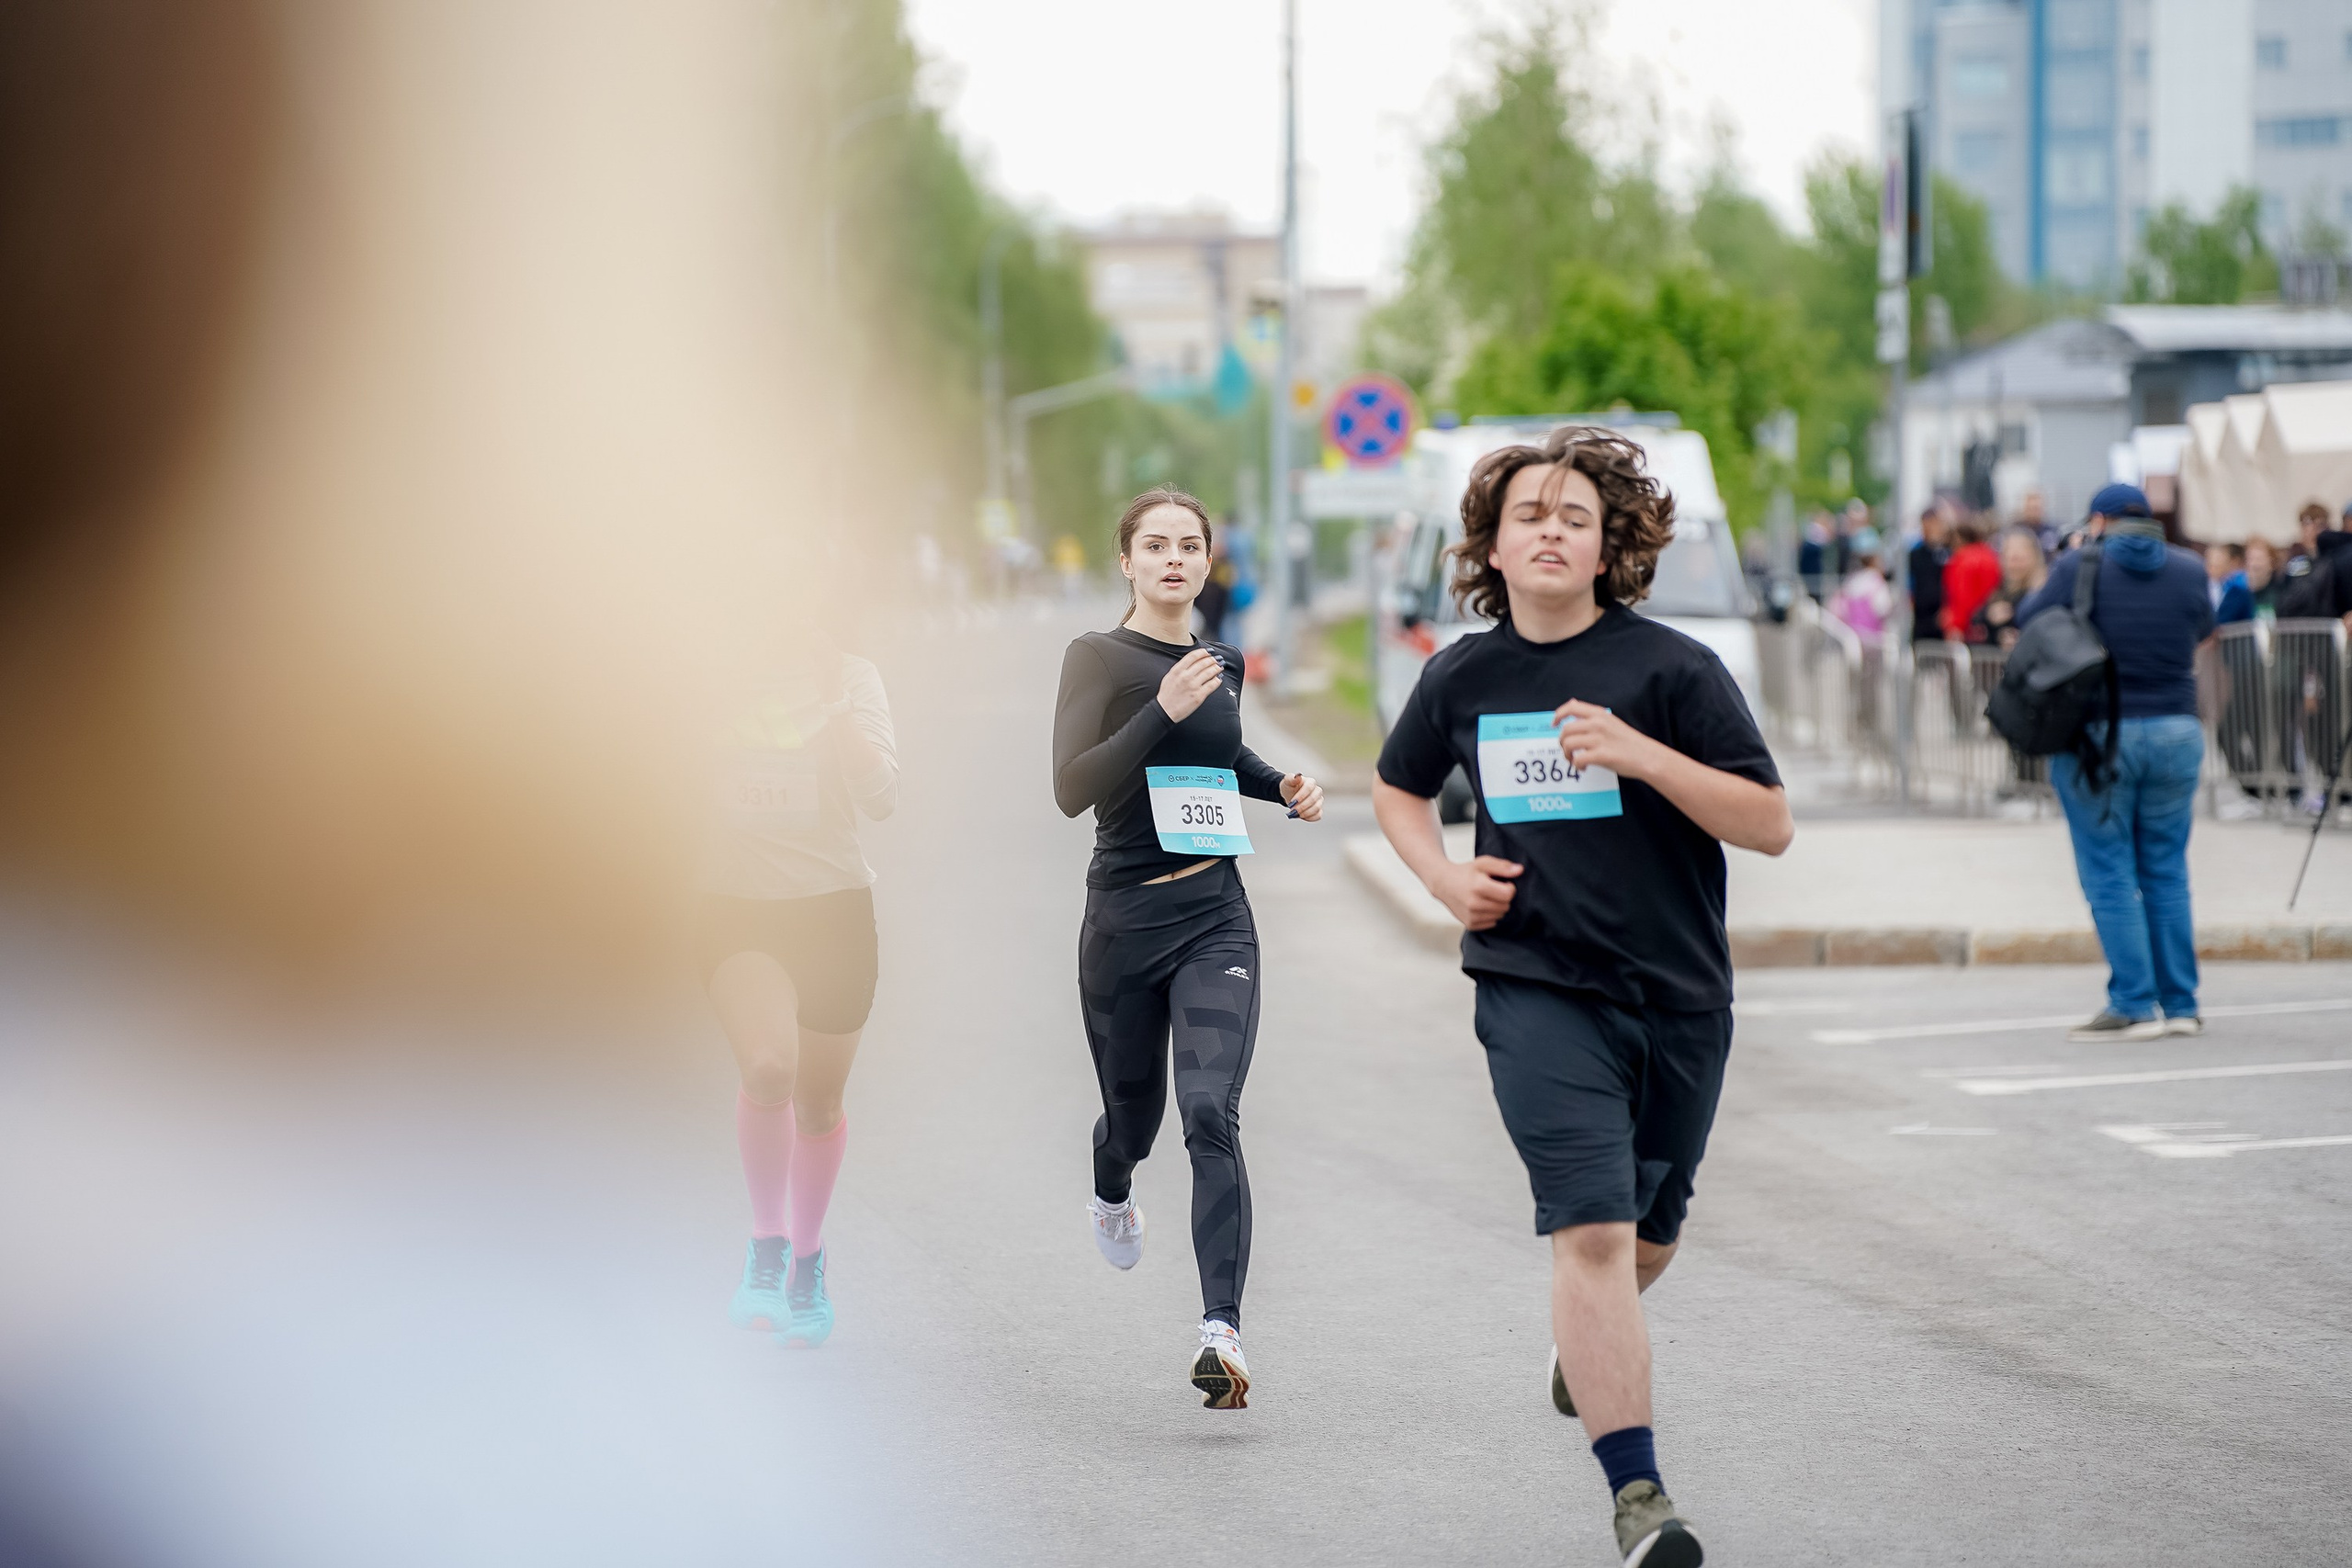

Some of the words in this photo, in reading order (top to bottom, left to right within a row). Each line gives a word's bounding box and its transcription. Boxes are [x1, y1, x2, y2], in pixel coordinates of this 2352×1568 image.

[1514, 759, 1580, 784] 3364
[737, 785, 789, 806] 3311
[1181, 804, 1225, 826] 3305
